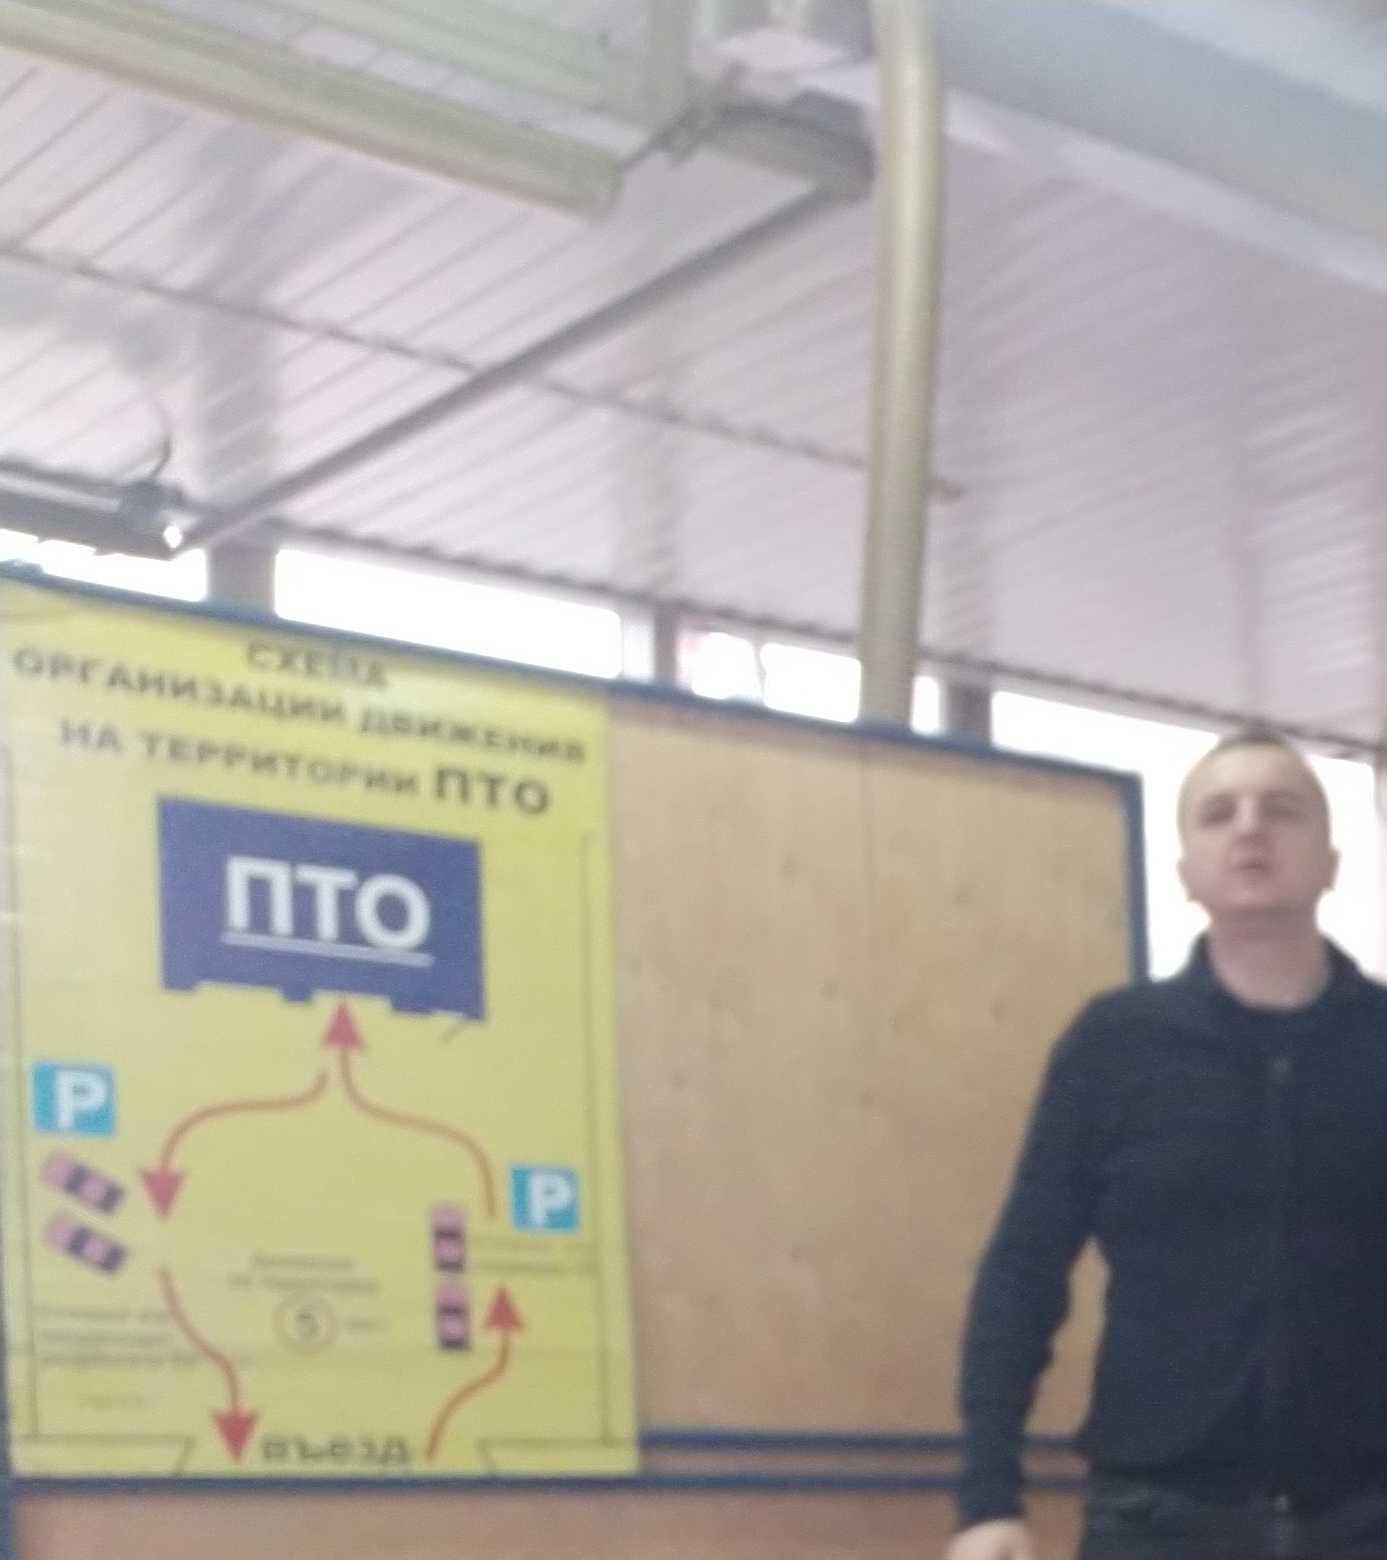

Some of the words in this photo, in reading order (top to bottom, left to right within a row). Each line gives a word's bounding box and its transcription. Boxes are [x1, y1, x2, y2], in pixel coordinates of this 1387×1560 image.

[13, 646, 346, 726] ОРГАНИЗАЦИИ
[359, 704, 588, 764] ДВИЖЕНИЯ
[60, 718, 122, 754] НА
[138, 728, 420, 796] ТЕРРИТОРИИ
[432, 765, 551, 816] ПТО
[226, 854, 432, 952] ПТО
[53, 1068, 109, 1130] P
[528, 1170, 577, 1227] P
